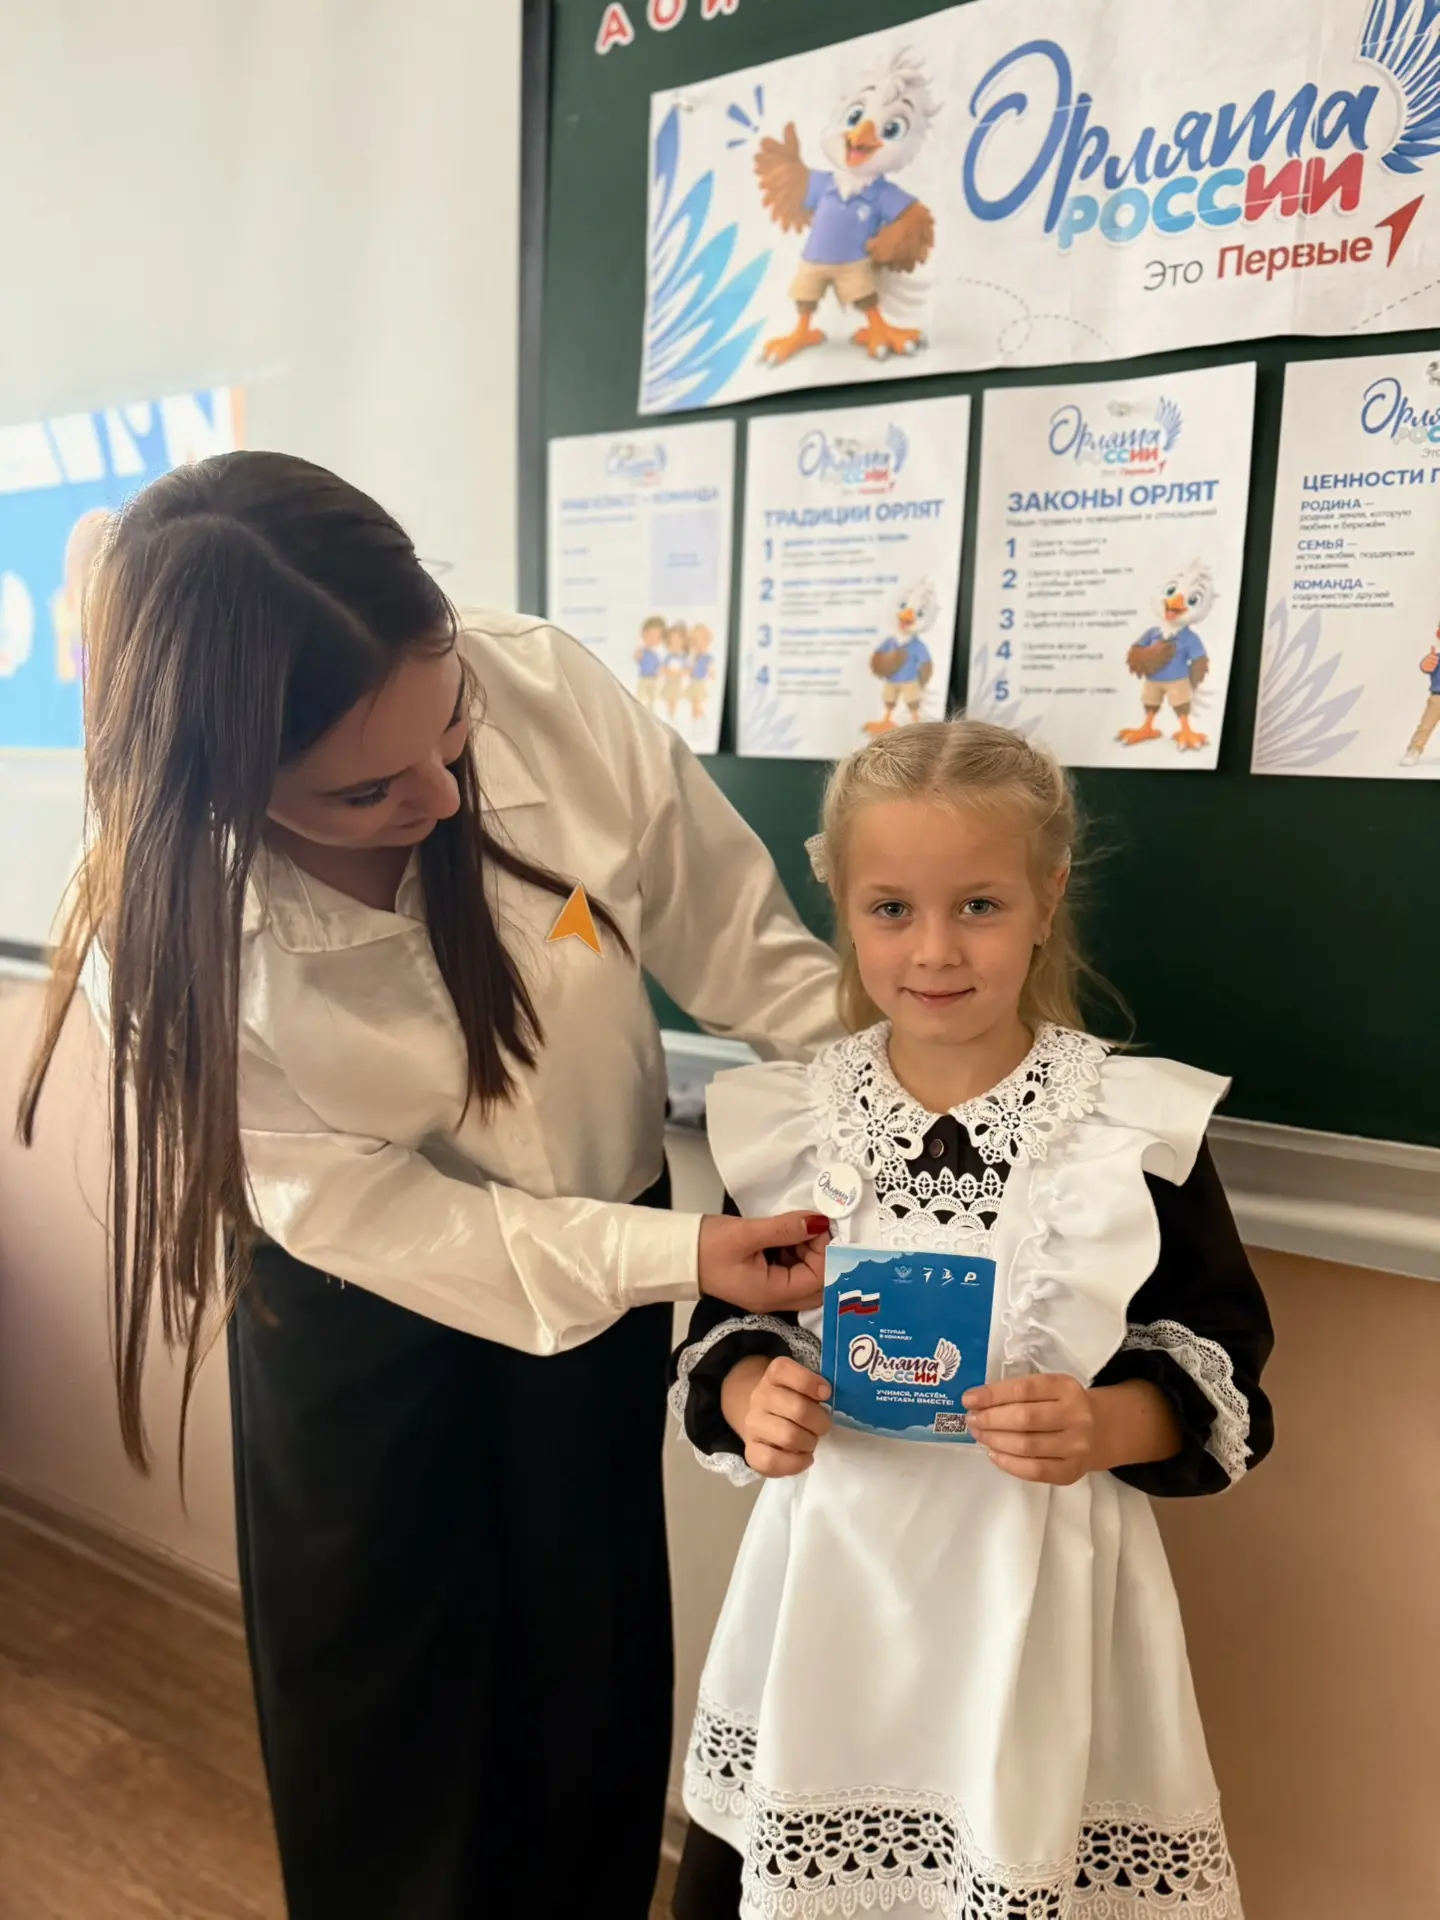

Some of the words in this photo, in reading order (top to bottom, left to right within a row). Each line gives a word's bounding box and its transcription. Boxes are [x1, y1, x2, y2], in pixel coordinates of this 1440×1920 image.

[962, 39, 1380, 234] Орлята
[1057, 152, 1365, 251] РОССИИ
[1143, 260, 1204, 291] Это
[1217, 236, 1373, 281] Первые
[1303, 468, 1424, 491] ЦЕННОСТИ
[1008, 488, 1124, 512] ЗАКОНЫ
[1129, 480, 1219, 506] ОРЛЯТ
[1301, 499, 1362, 512] РОДИНА
[764, 505, 871, 528] ТРАДИЦИИ
[875, 499, 945, 521] ОРЛЯТ
[765, 538, 773, 561] 1
[1006, 538, 1016, 558] 1
[1297, 539, 1344, 551] СЕМЬЯ
[760, 577, 774, 601] 2
[1002, 569, 1017, 589] 2
[1293, 578, 1363, 591] КОМАНДА
[1000, 609, 1014, 630] 3
[758, 624, 771, 648] 3
[995, 640, 1012, 660] 4
[756, 665, 770, 685] 4
[995, 681, 1009, 701] 5
[851, 1336, 939, 1374] Орлята
[876, 1395, 915, 1403] МЕЧТАЕМ
